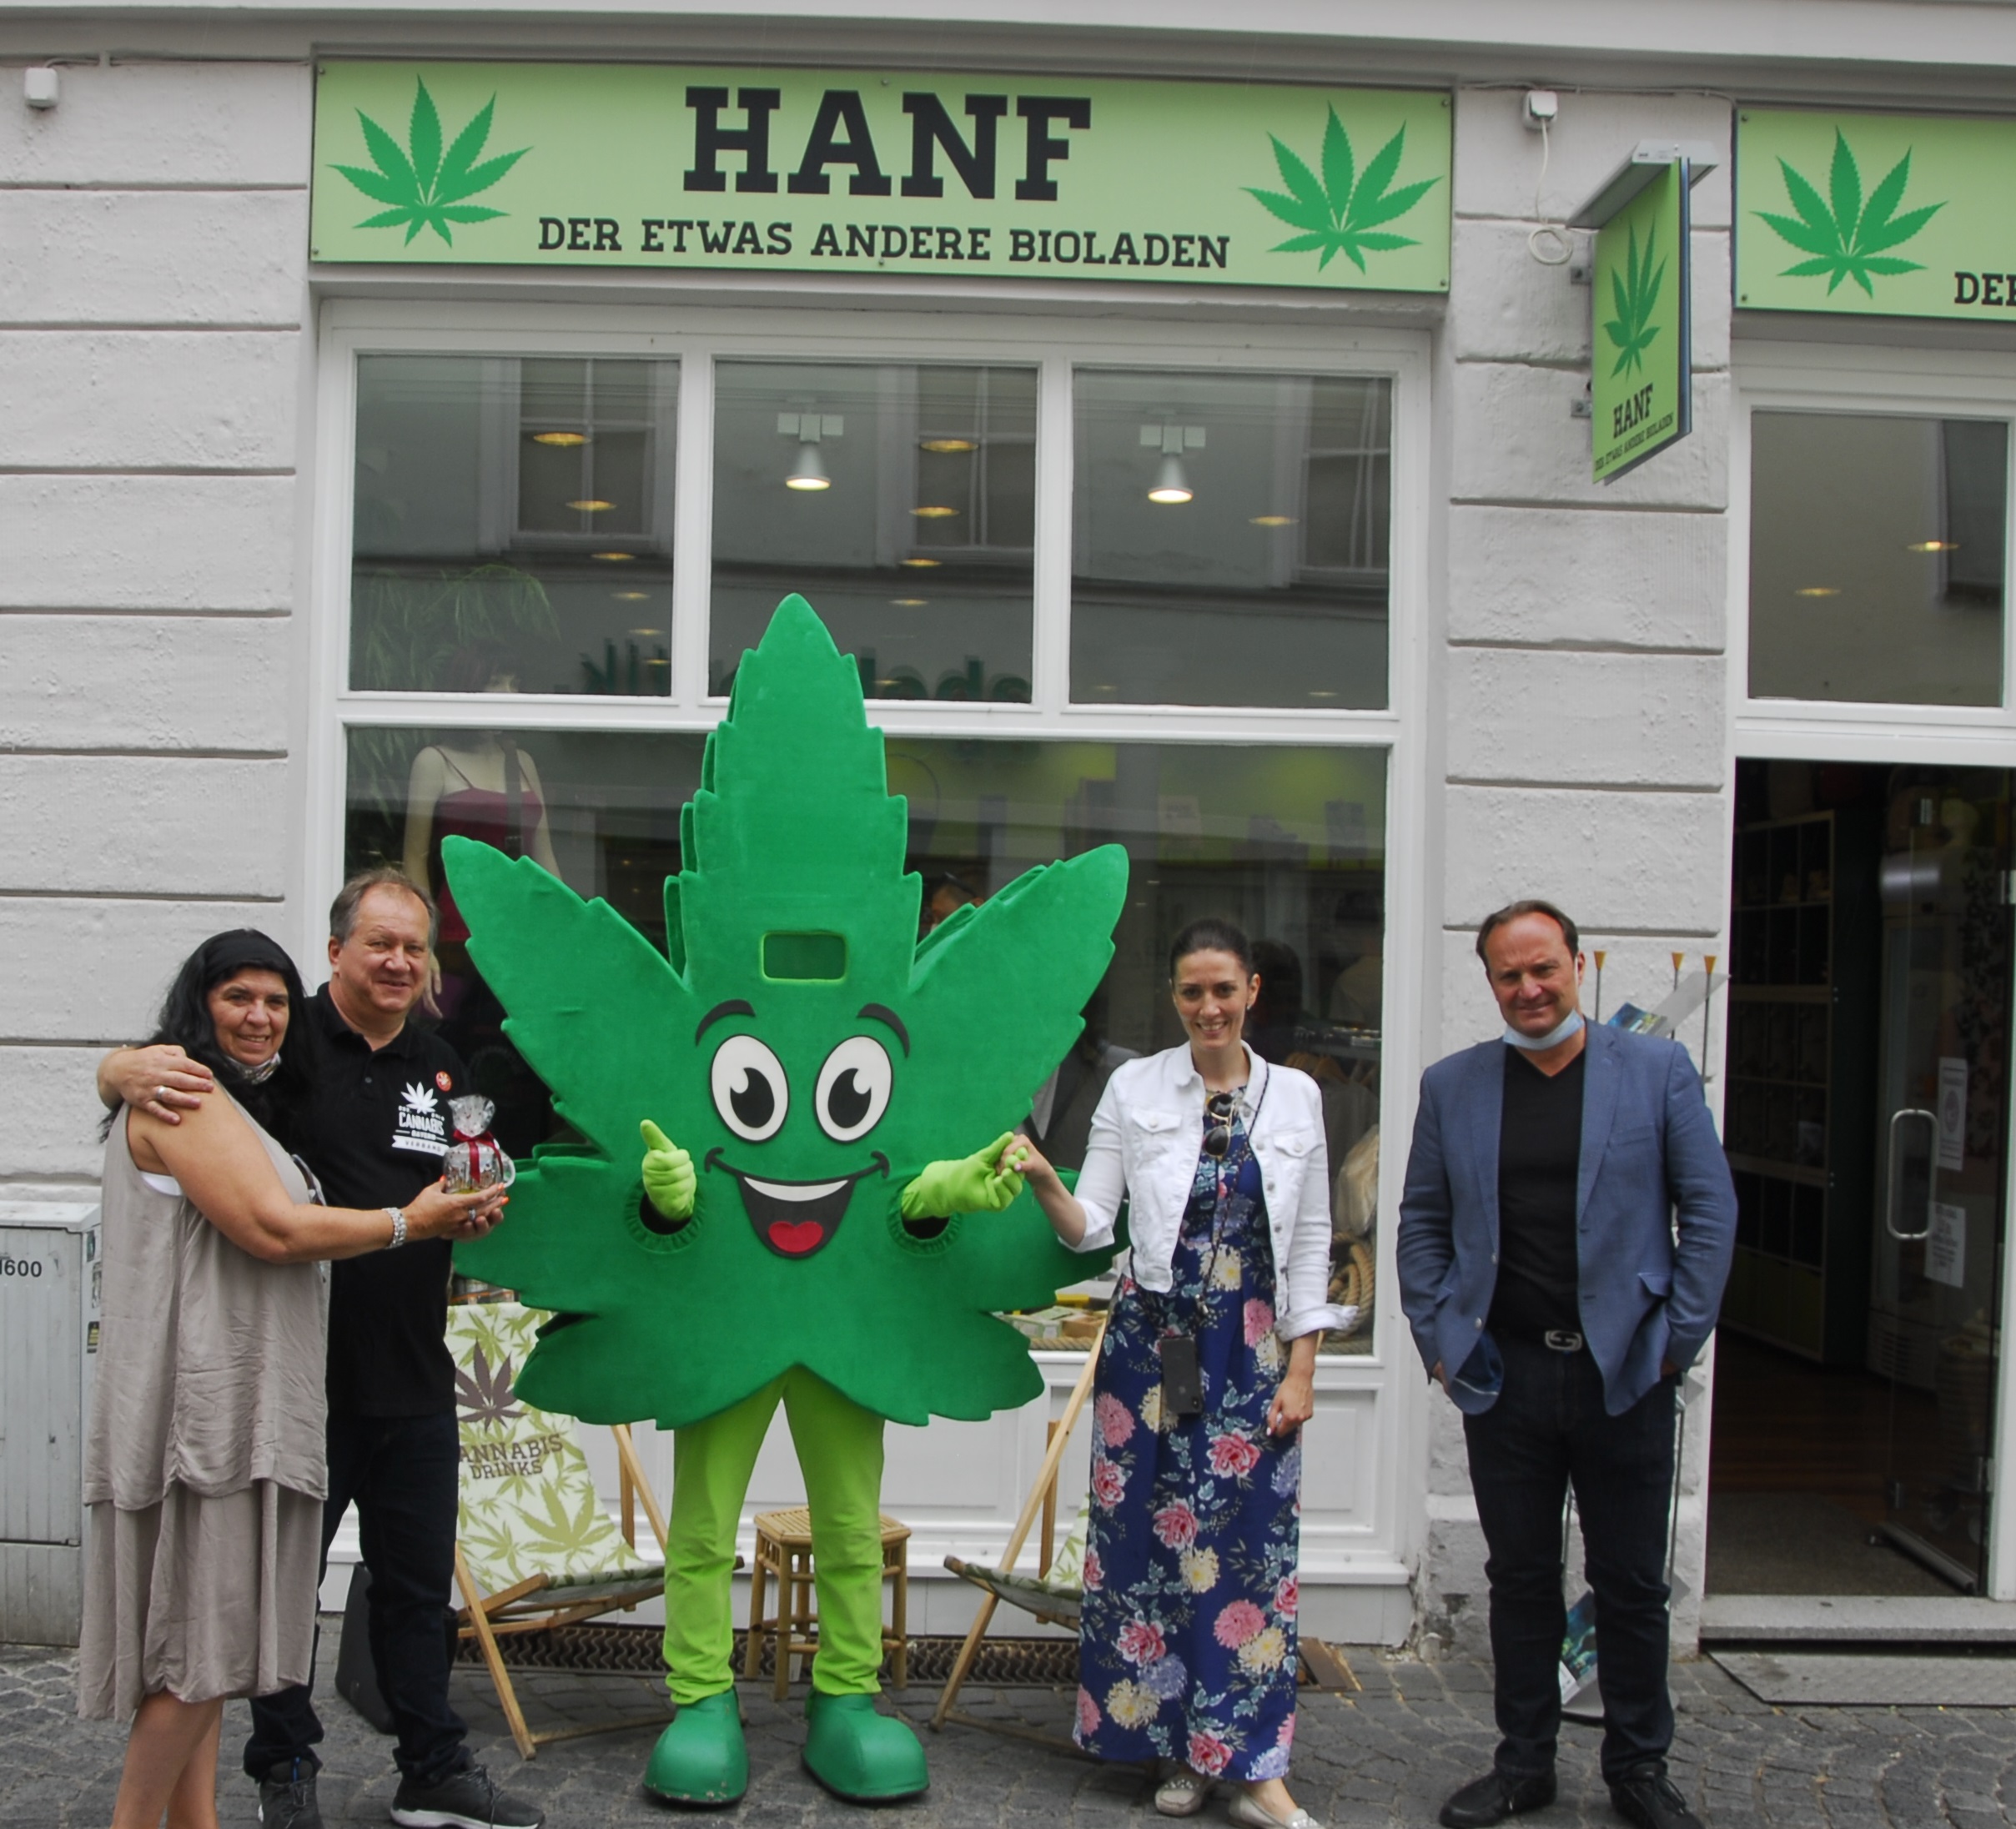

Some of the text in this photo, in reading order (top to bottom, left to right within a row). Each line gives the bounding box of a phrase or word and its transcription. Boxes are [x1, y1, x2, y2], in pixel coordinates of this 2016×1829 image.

[684, 85, 1092, 202] HANF
[538, 217, 1230, 269] DER ETWAS ANDERE BIOLADEN
[1613, 382, 1653, 439] HANF
[399, 1111, 445, 1136] CANNABIS
[405, 1139, 441, 1153] VERBAND
[459, 1433, 563, 1464] ANNABIS
[469, 1459, 543, 1480] DRINKS
